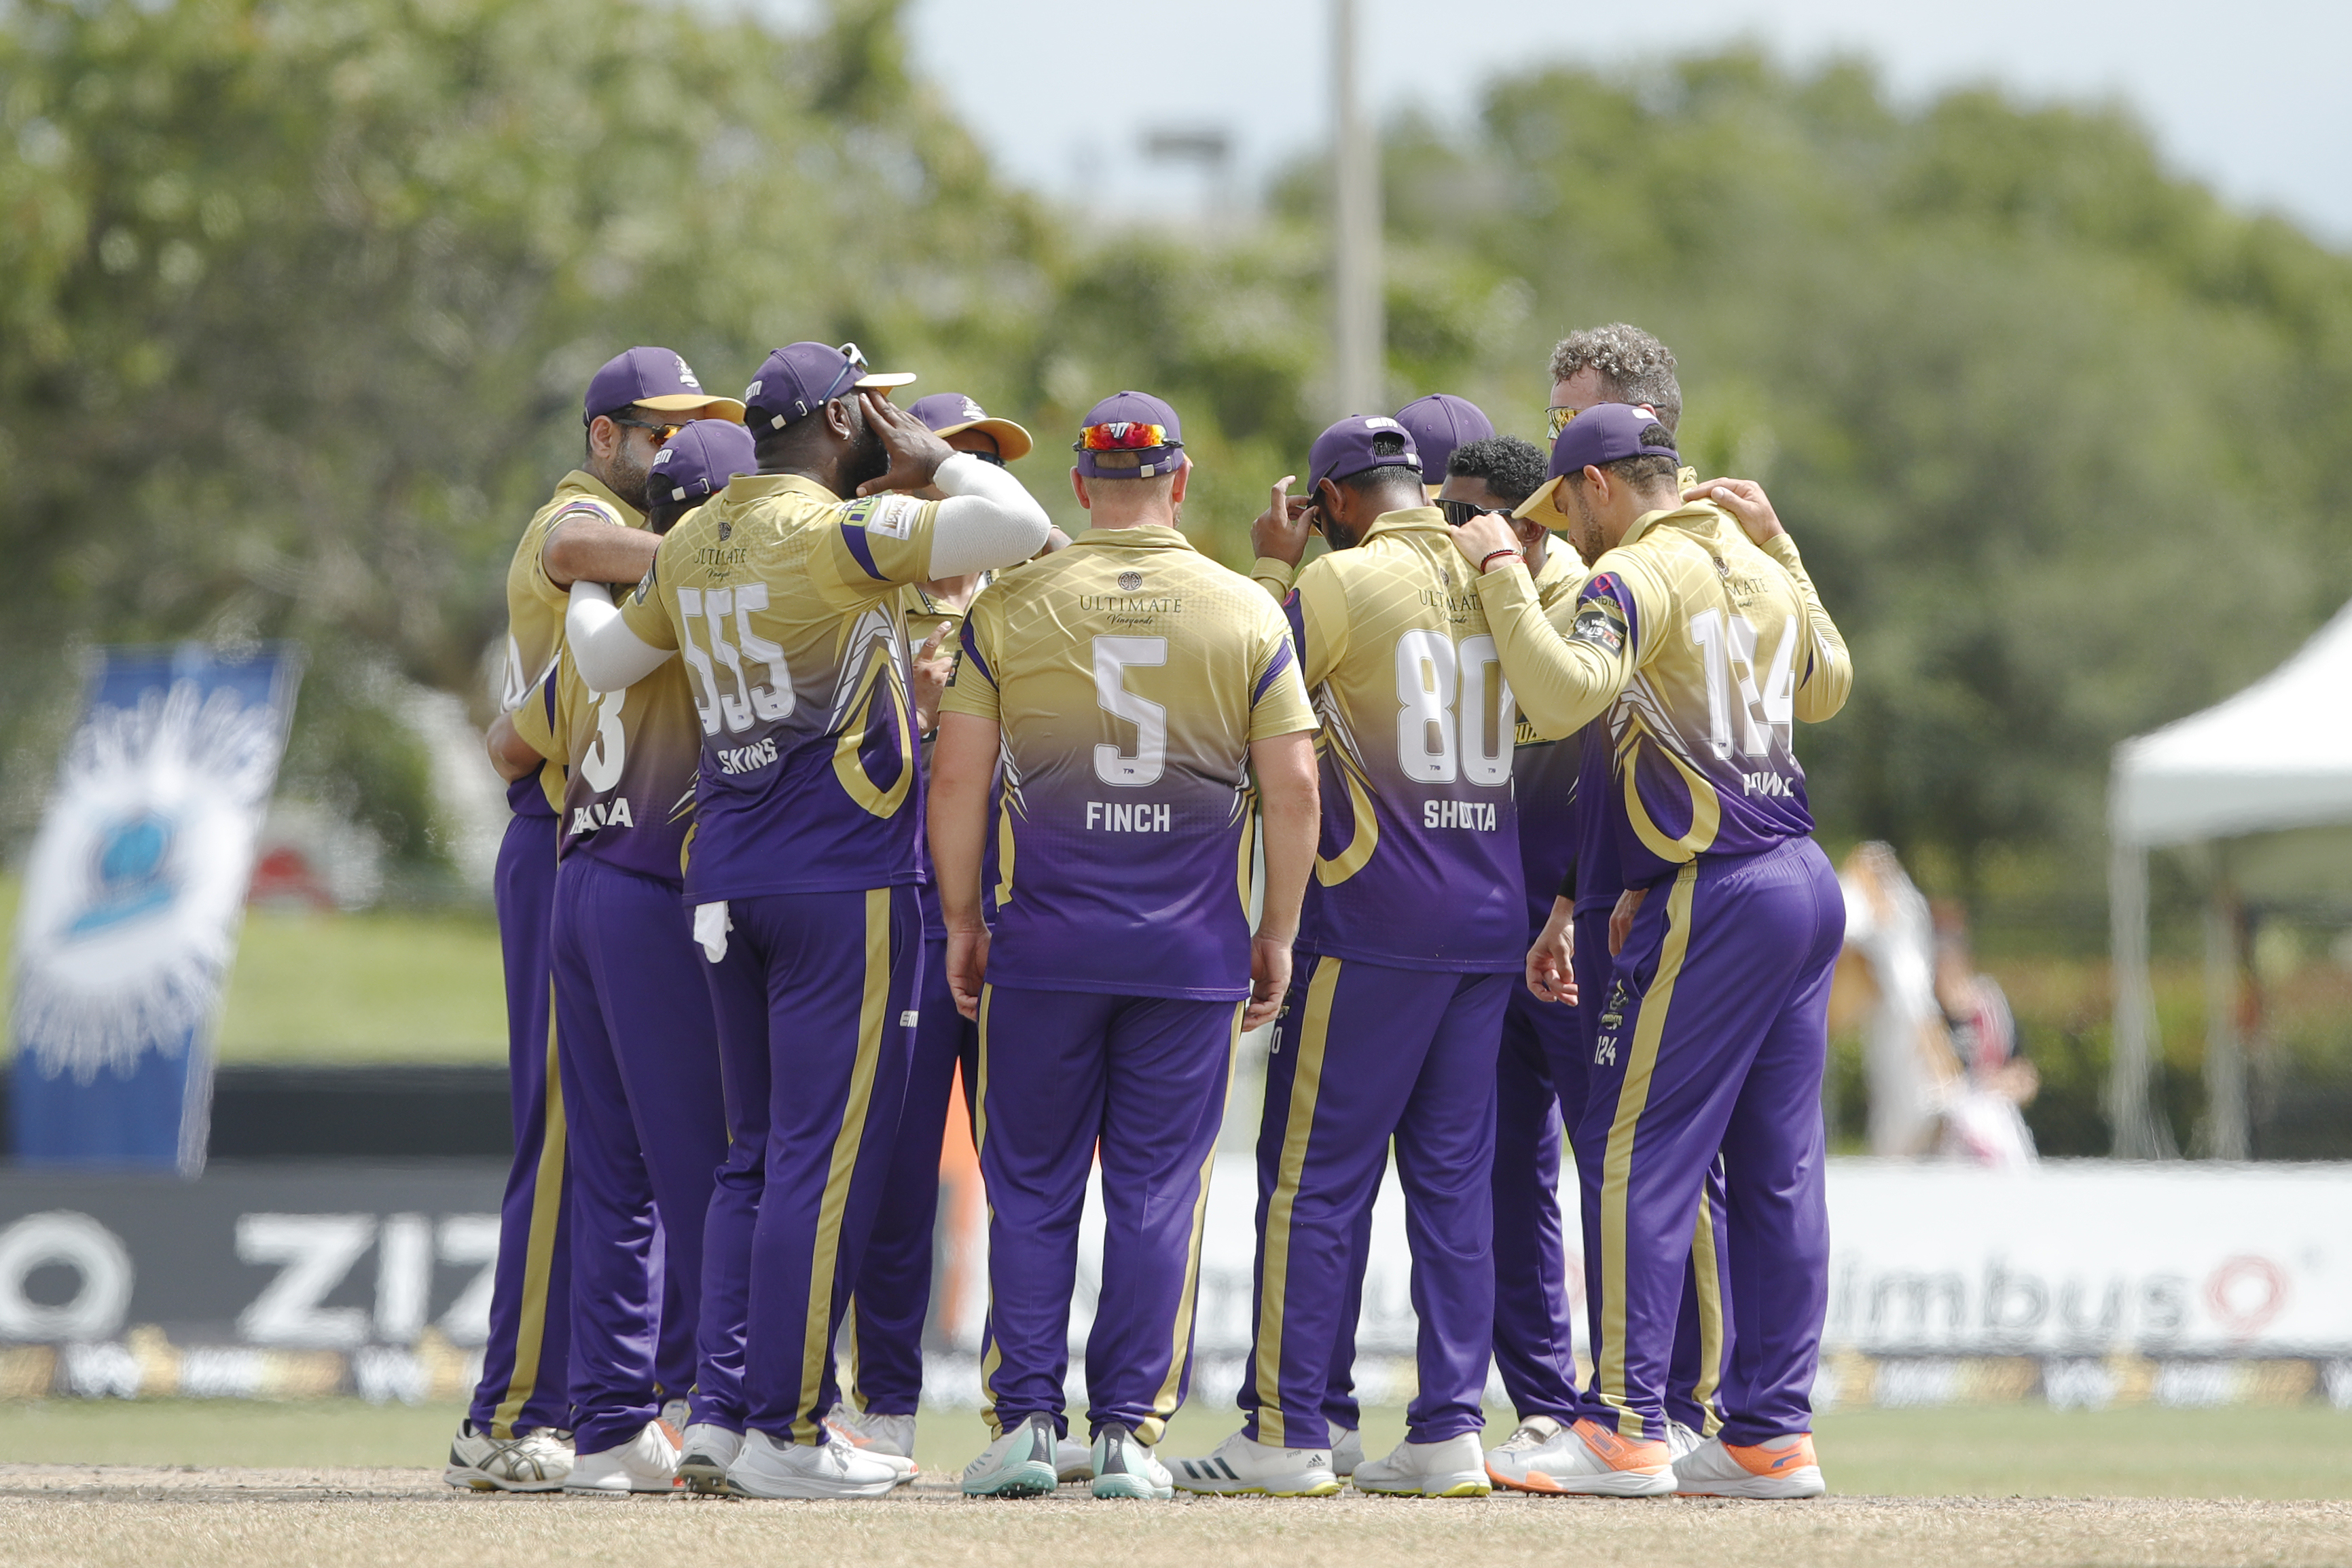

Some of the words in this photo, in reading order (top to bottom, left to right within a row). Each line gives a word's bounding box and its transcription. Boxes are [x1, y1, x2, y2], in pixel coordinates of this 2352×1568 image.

[1079, 594, 1182, 613] ULTIMATE
[1106, 613, 1154, 629] Vineyards
[676, 581, 796, 736] 555
[1092, 634, 1168, 787] 5
[1394, 628, 1516, 787] 80
[581, 687, 626, 793] 3
[717, 737, 778, 775] SKINS
[1086, 800, 1171, 833] FINCH
[1593, 1035, 1618, 1067] 124
